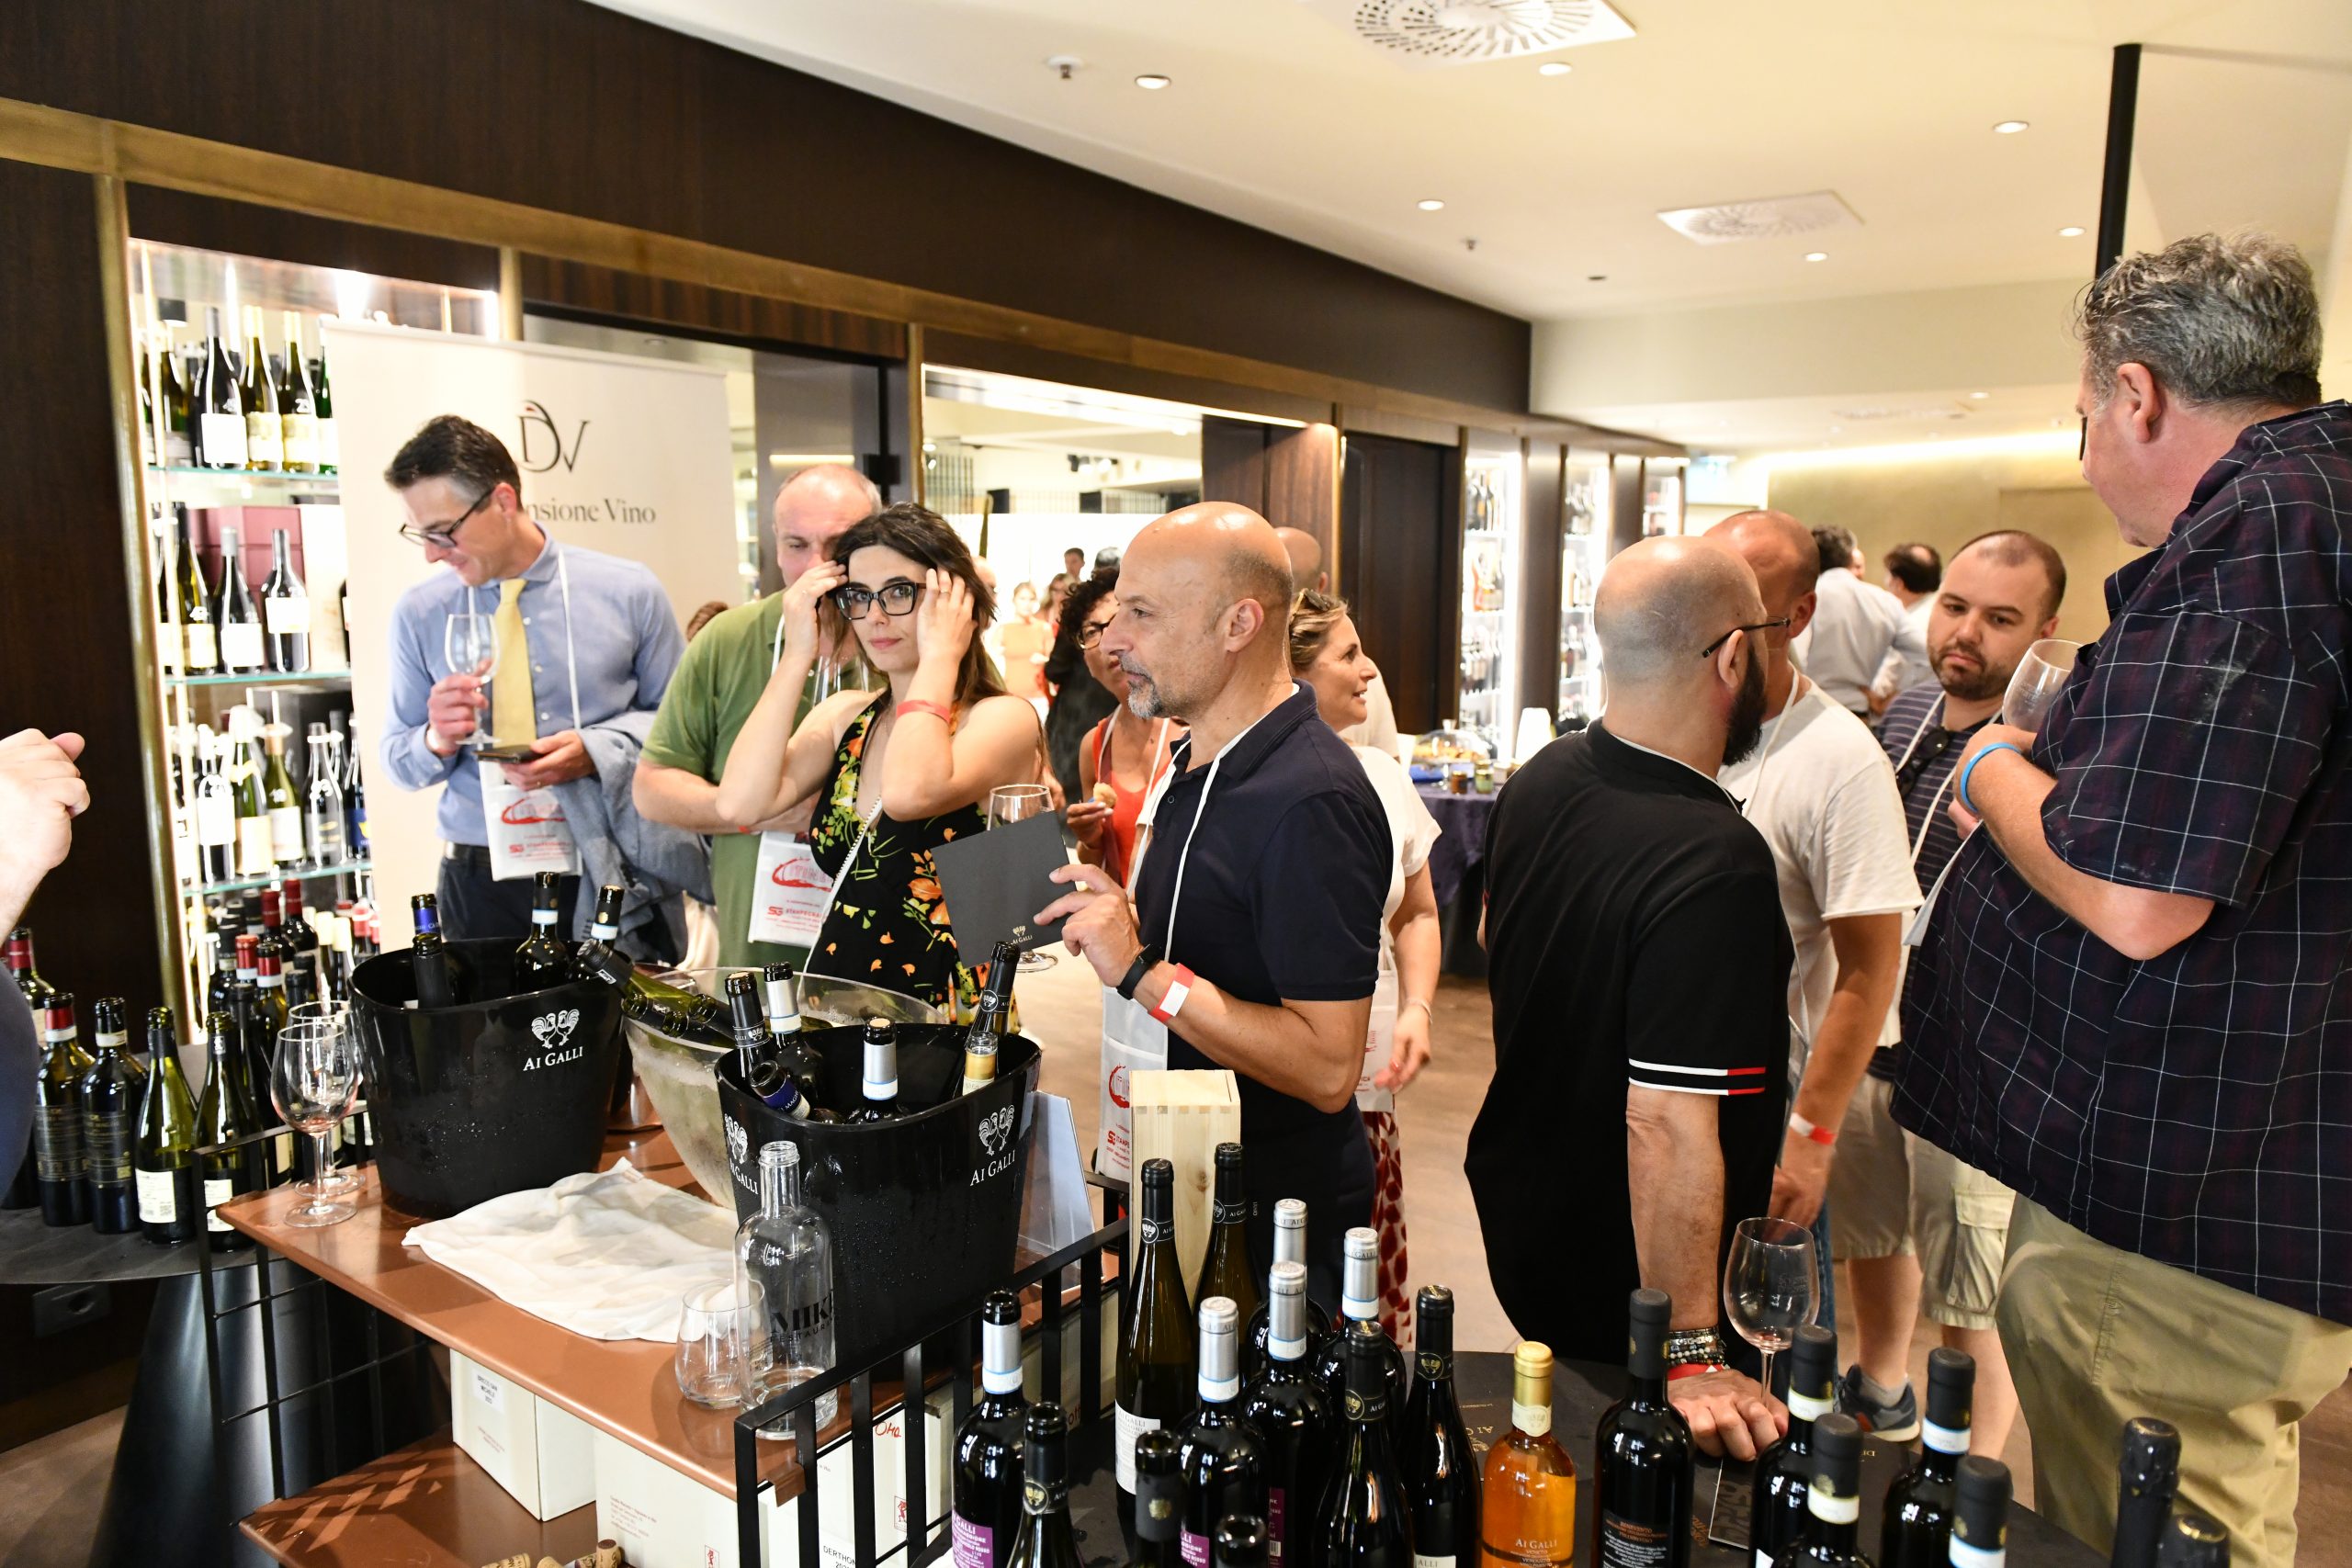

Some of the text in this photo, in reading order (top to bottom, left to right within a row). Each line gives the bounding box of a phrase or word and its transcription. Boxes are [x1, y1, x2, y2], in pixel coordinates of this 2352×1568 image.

[604, 499, 657, 524] Vino
[523, 1046, 582, 1071] AI GALLI
[970, 1149, 1016, 1186] AI GALLI
[735, 1167, 759, 1195] GALLI
[1516, 1539, 1557, 1550] AI GALLI
